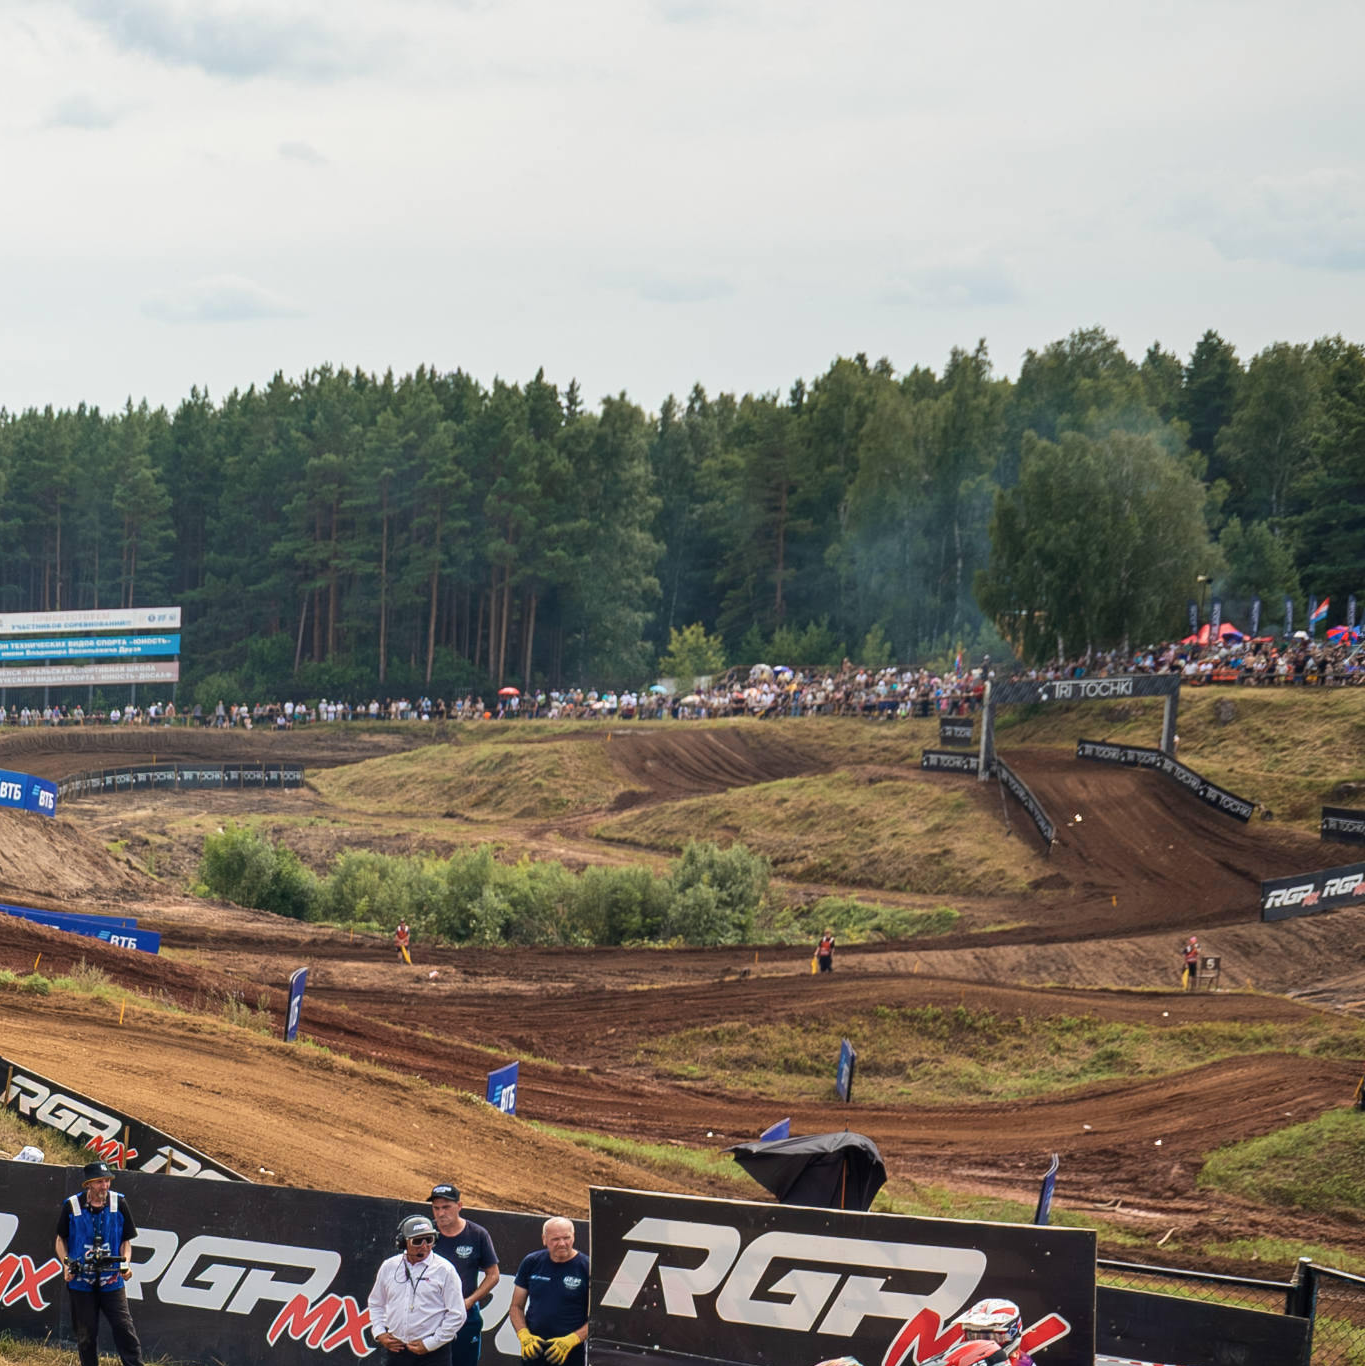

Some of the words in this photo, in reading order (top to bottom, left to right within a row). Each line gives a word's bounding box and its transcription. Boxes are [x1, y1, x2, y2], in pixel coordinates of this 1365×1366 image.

[11, 641, 66, 649] ТЕХНИЧЕСКИХ
[68, 640, 95, 648] ВИДОВ
[1079, 678, 1133, 697] TOCHKI
[0, 781, 22, 801] ВТБ
[38, 789, 54, 810] ВТБ
[600, 1216, 988, 1338] RGP
[267, 1292, 376, 1358] MX
